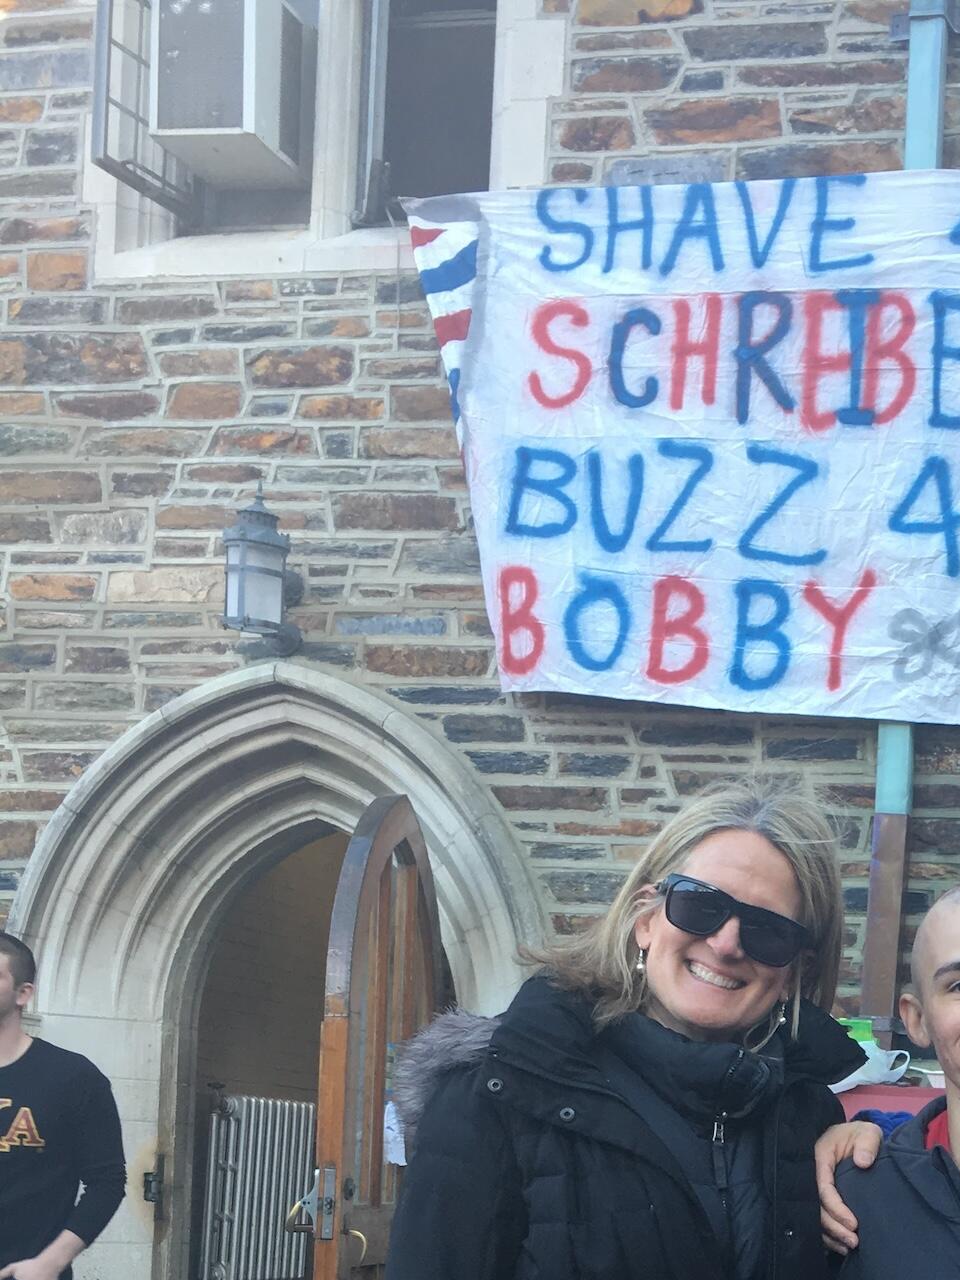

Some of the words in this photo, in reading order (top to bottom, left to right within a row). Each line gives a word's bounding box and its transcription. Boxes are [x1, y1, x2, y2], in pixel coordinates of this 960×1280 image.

[535, 173, 875, 276] SHAVE
[503, 439, 828, 567] BUZZ
[496, 565, 878, 692] BOBBY
